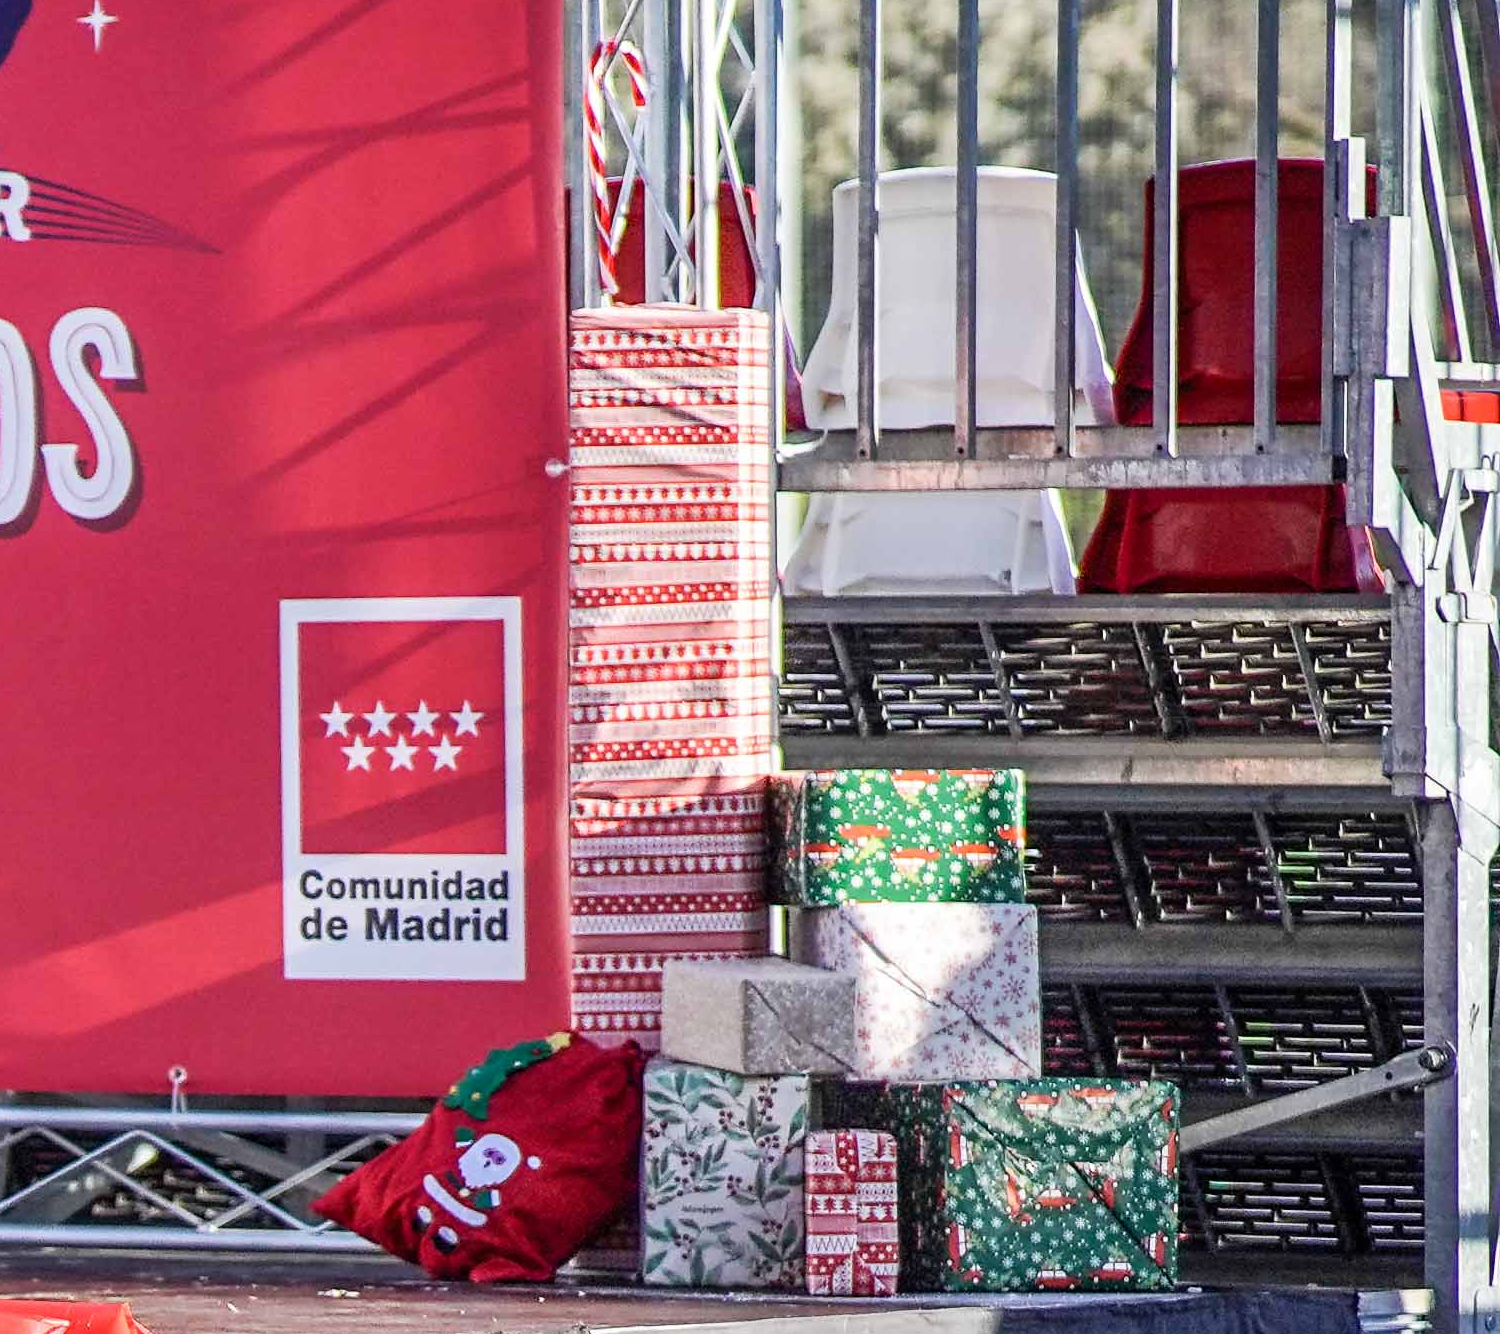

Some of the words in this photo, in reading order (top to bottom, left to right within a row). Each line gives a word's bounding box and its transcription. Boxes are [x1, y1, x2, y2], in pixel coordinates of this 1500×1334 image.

[299, 869, 510, 901] Comunidad
[300, 907, 349, 940] de
[364, 907, 510, 941] Madrid
